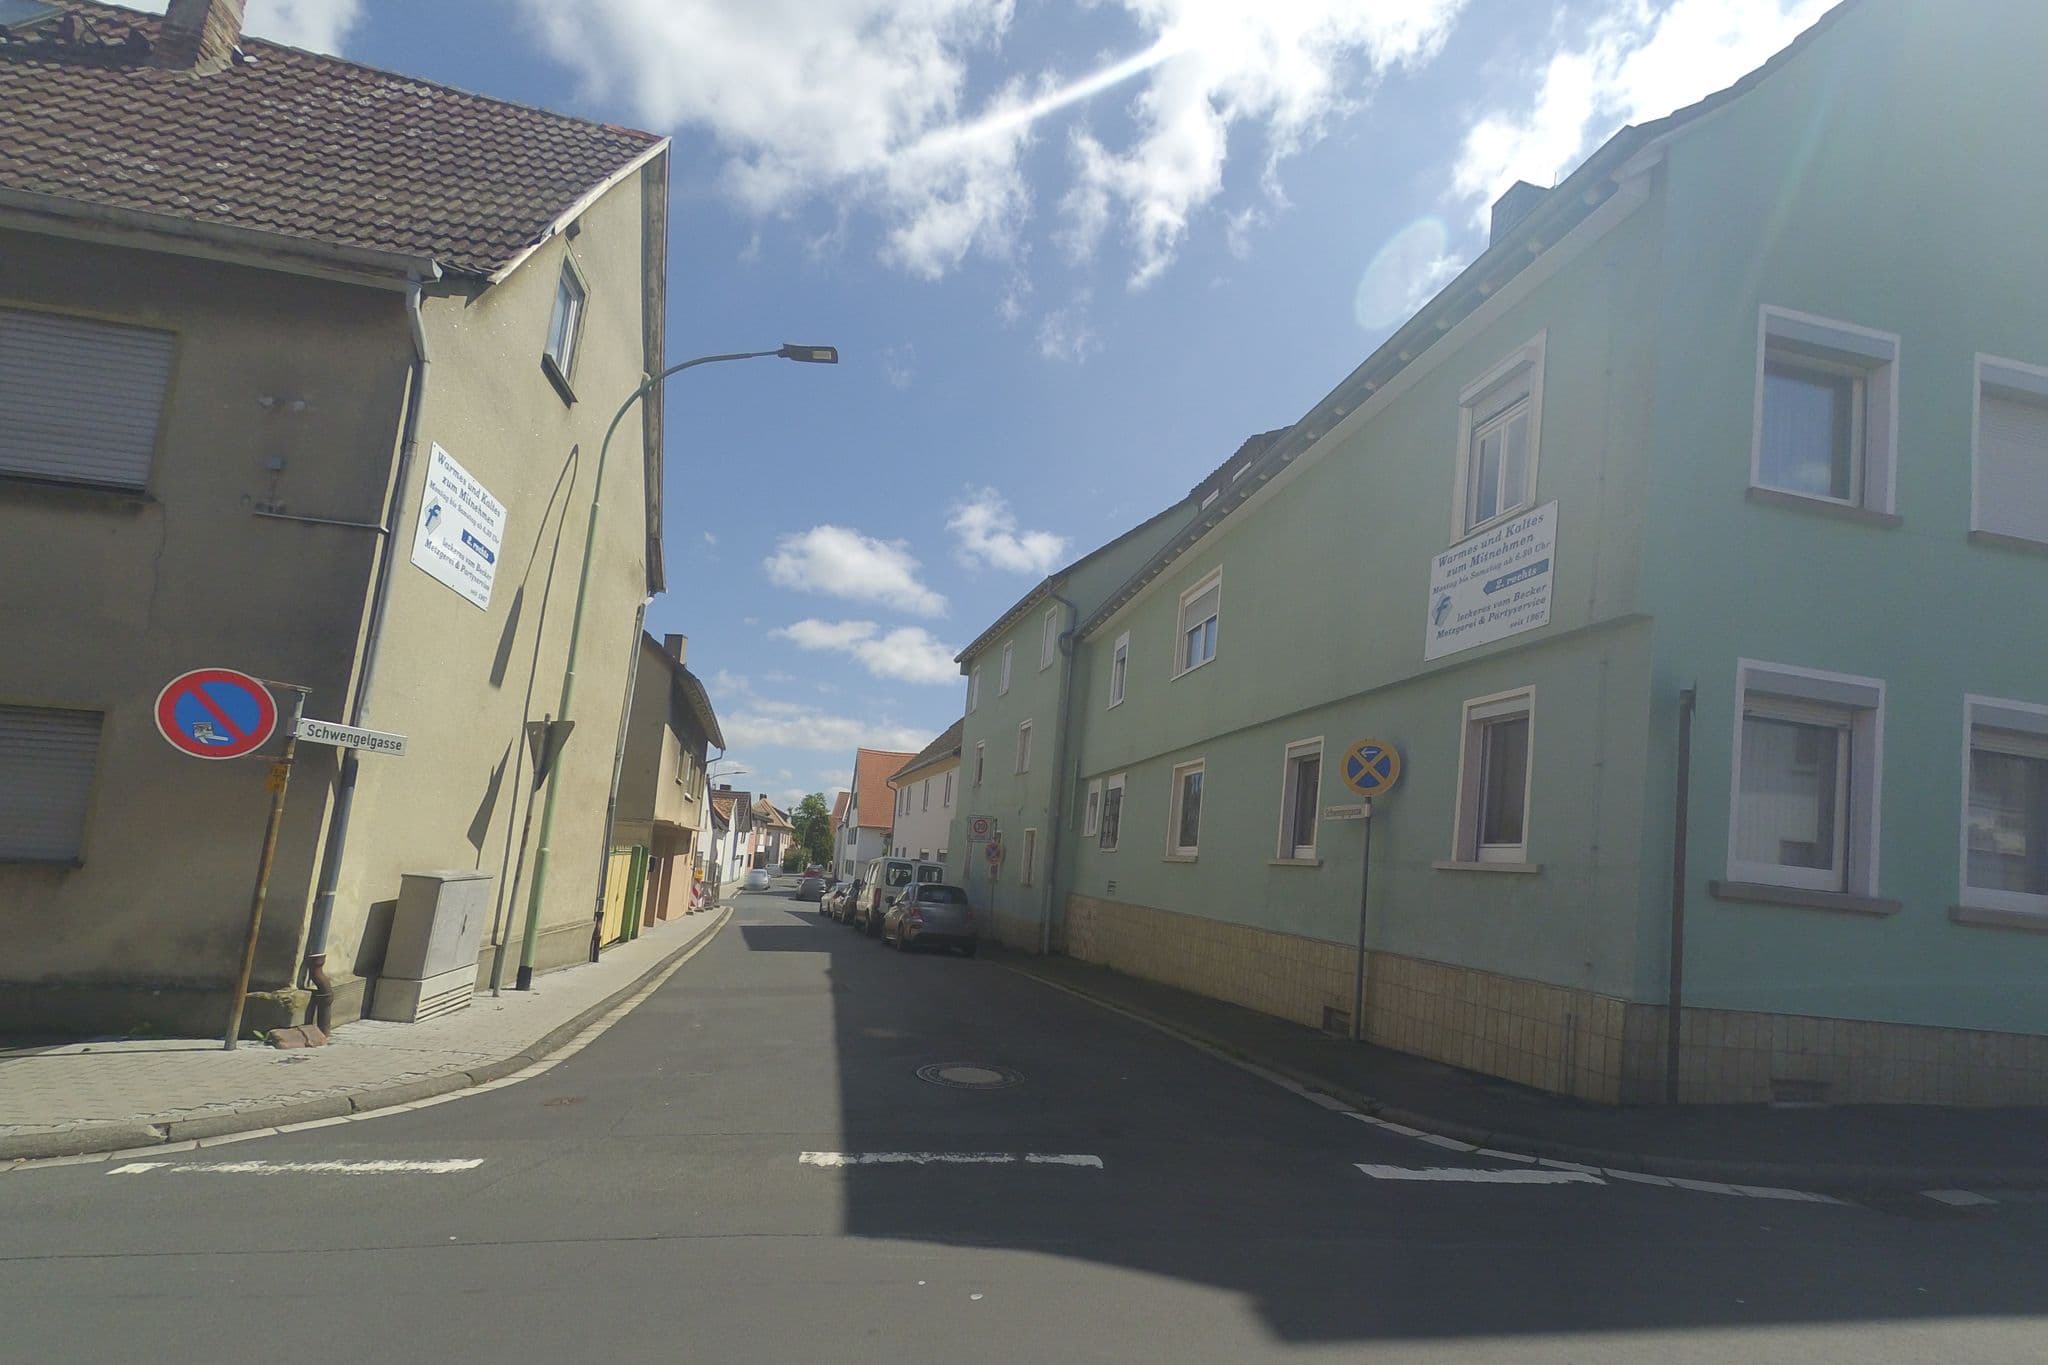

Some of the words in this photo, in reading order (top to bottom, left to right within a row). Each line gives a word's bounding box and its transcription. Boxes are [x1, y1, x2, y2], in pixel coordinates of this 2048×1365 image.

[438, 451, 466, 485] Warmes
[467, 482, 481, 499] und
[481, 493, 501, 518] Kaltes
[442, 476, 458, 494] zum
[459, 488, 495, 528] Mitnehmen
[424, 538, 454, 567] Metzgerei
[1439, 545, 1477, 568] Warmes
[1481, 531, 1502, 549] und
[1506, 514, 1544, 538] Kaltes
[1447, 563, 1467, 578] zum
[1469, 534, 1533, 568] Mitnehmen
[1435, 621, 1476, 640] Metzgerei
[1479, 615, 1486, 625] &
[1488, 597, 1547, 623] Partyservice
[1493, 598, 1511, 609] vom
[307, 724, 402, 751] Schwengelgasse
